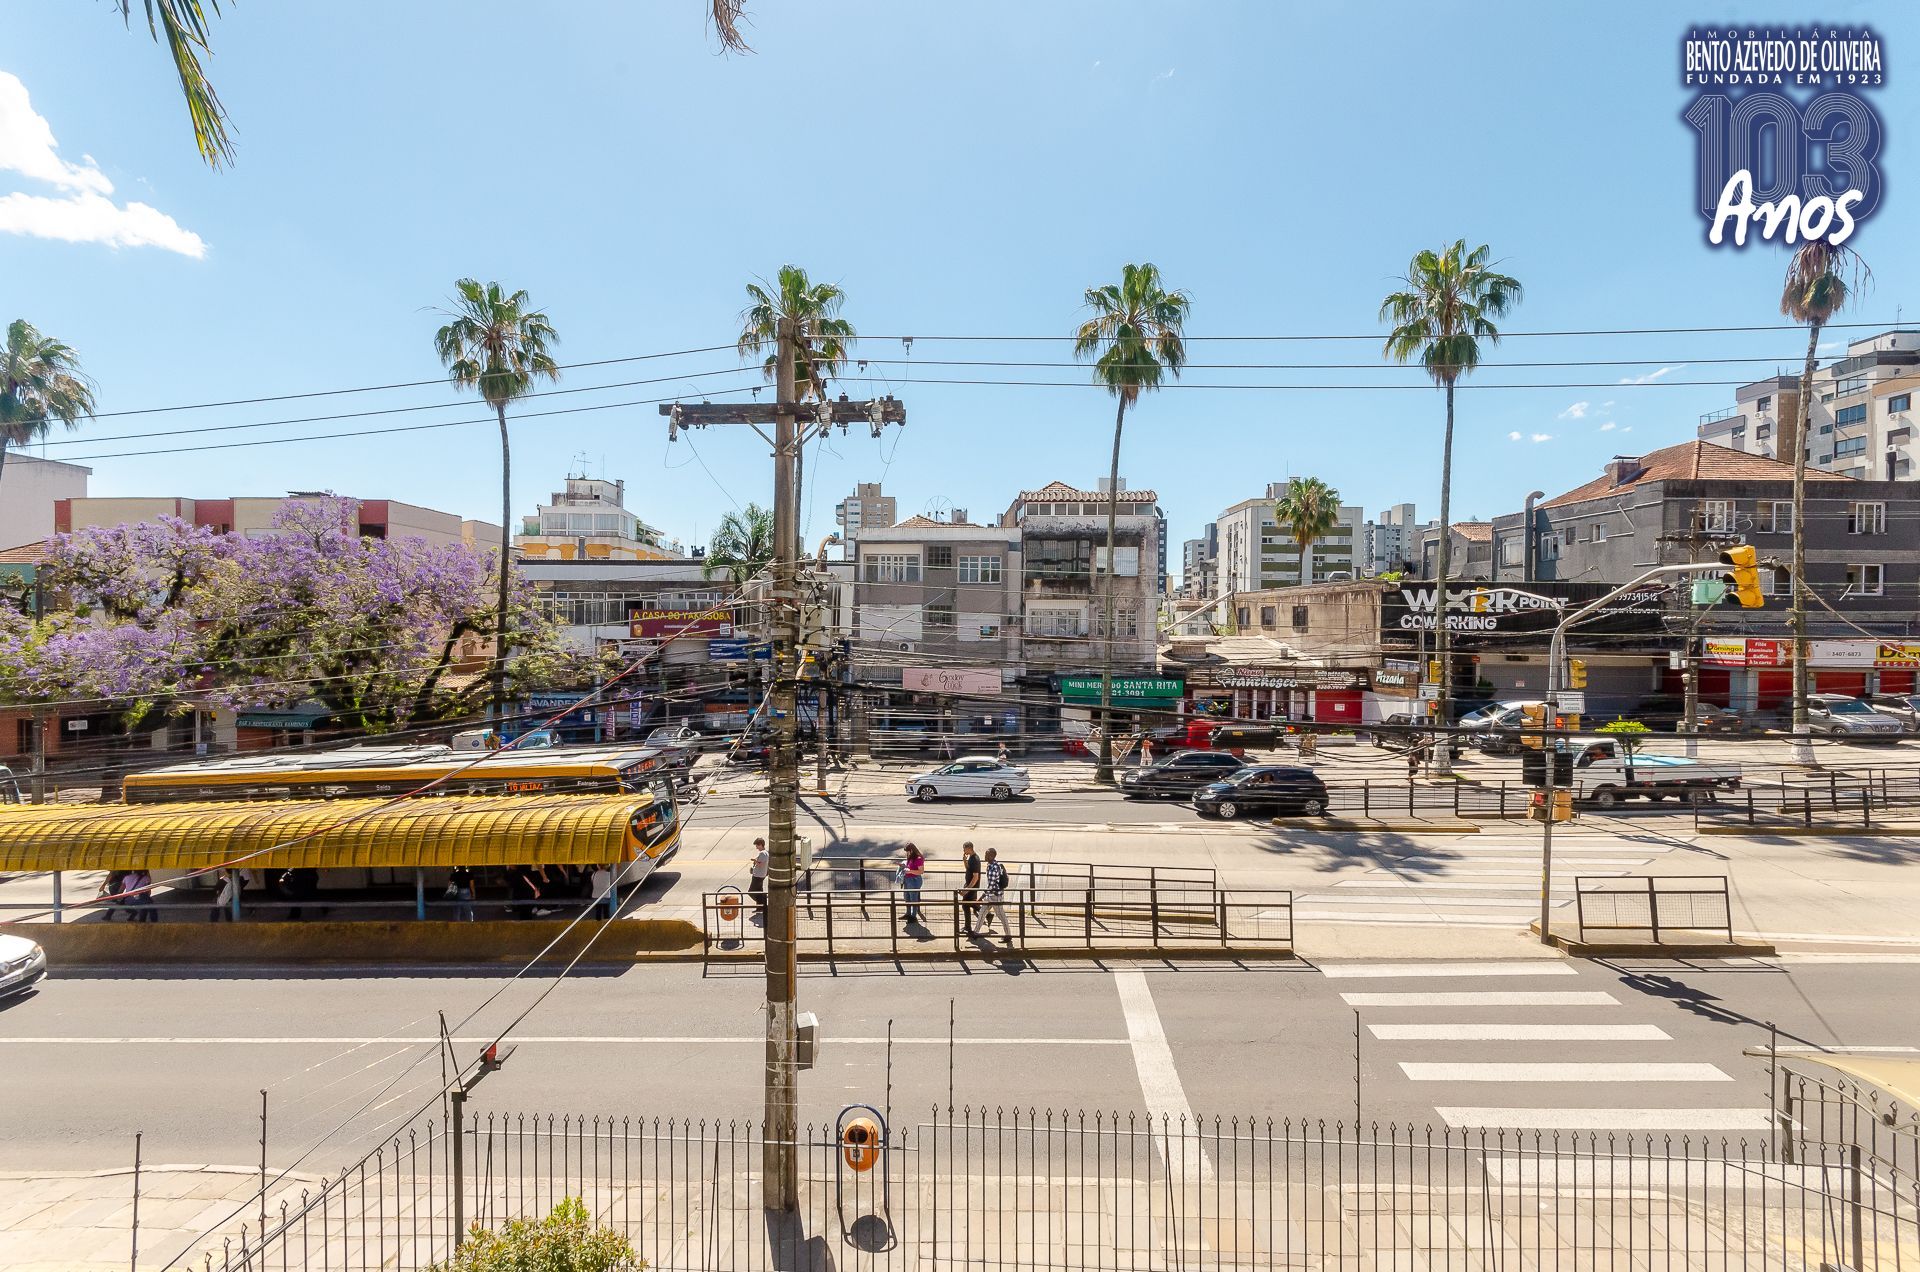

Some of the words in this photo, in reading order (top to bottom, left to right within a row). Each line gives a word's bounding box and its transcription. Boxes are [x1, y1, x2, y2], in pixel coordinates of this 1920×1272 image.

[642, 611, 665, 620] CASA
[1068, 681, 1085, 689] MINI
[1086, 681, 1121, 689] MERDO
[1123, 681, 1153, 689] SANTA
[1156, 681, 1178, 690] RITA
